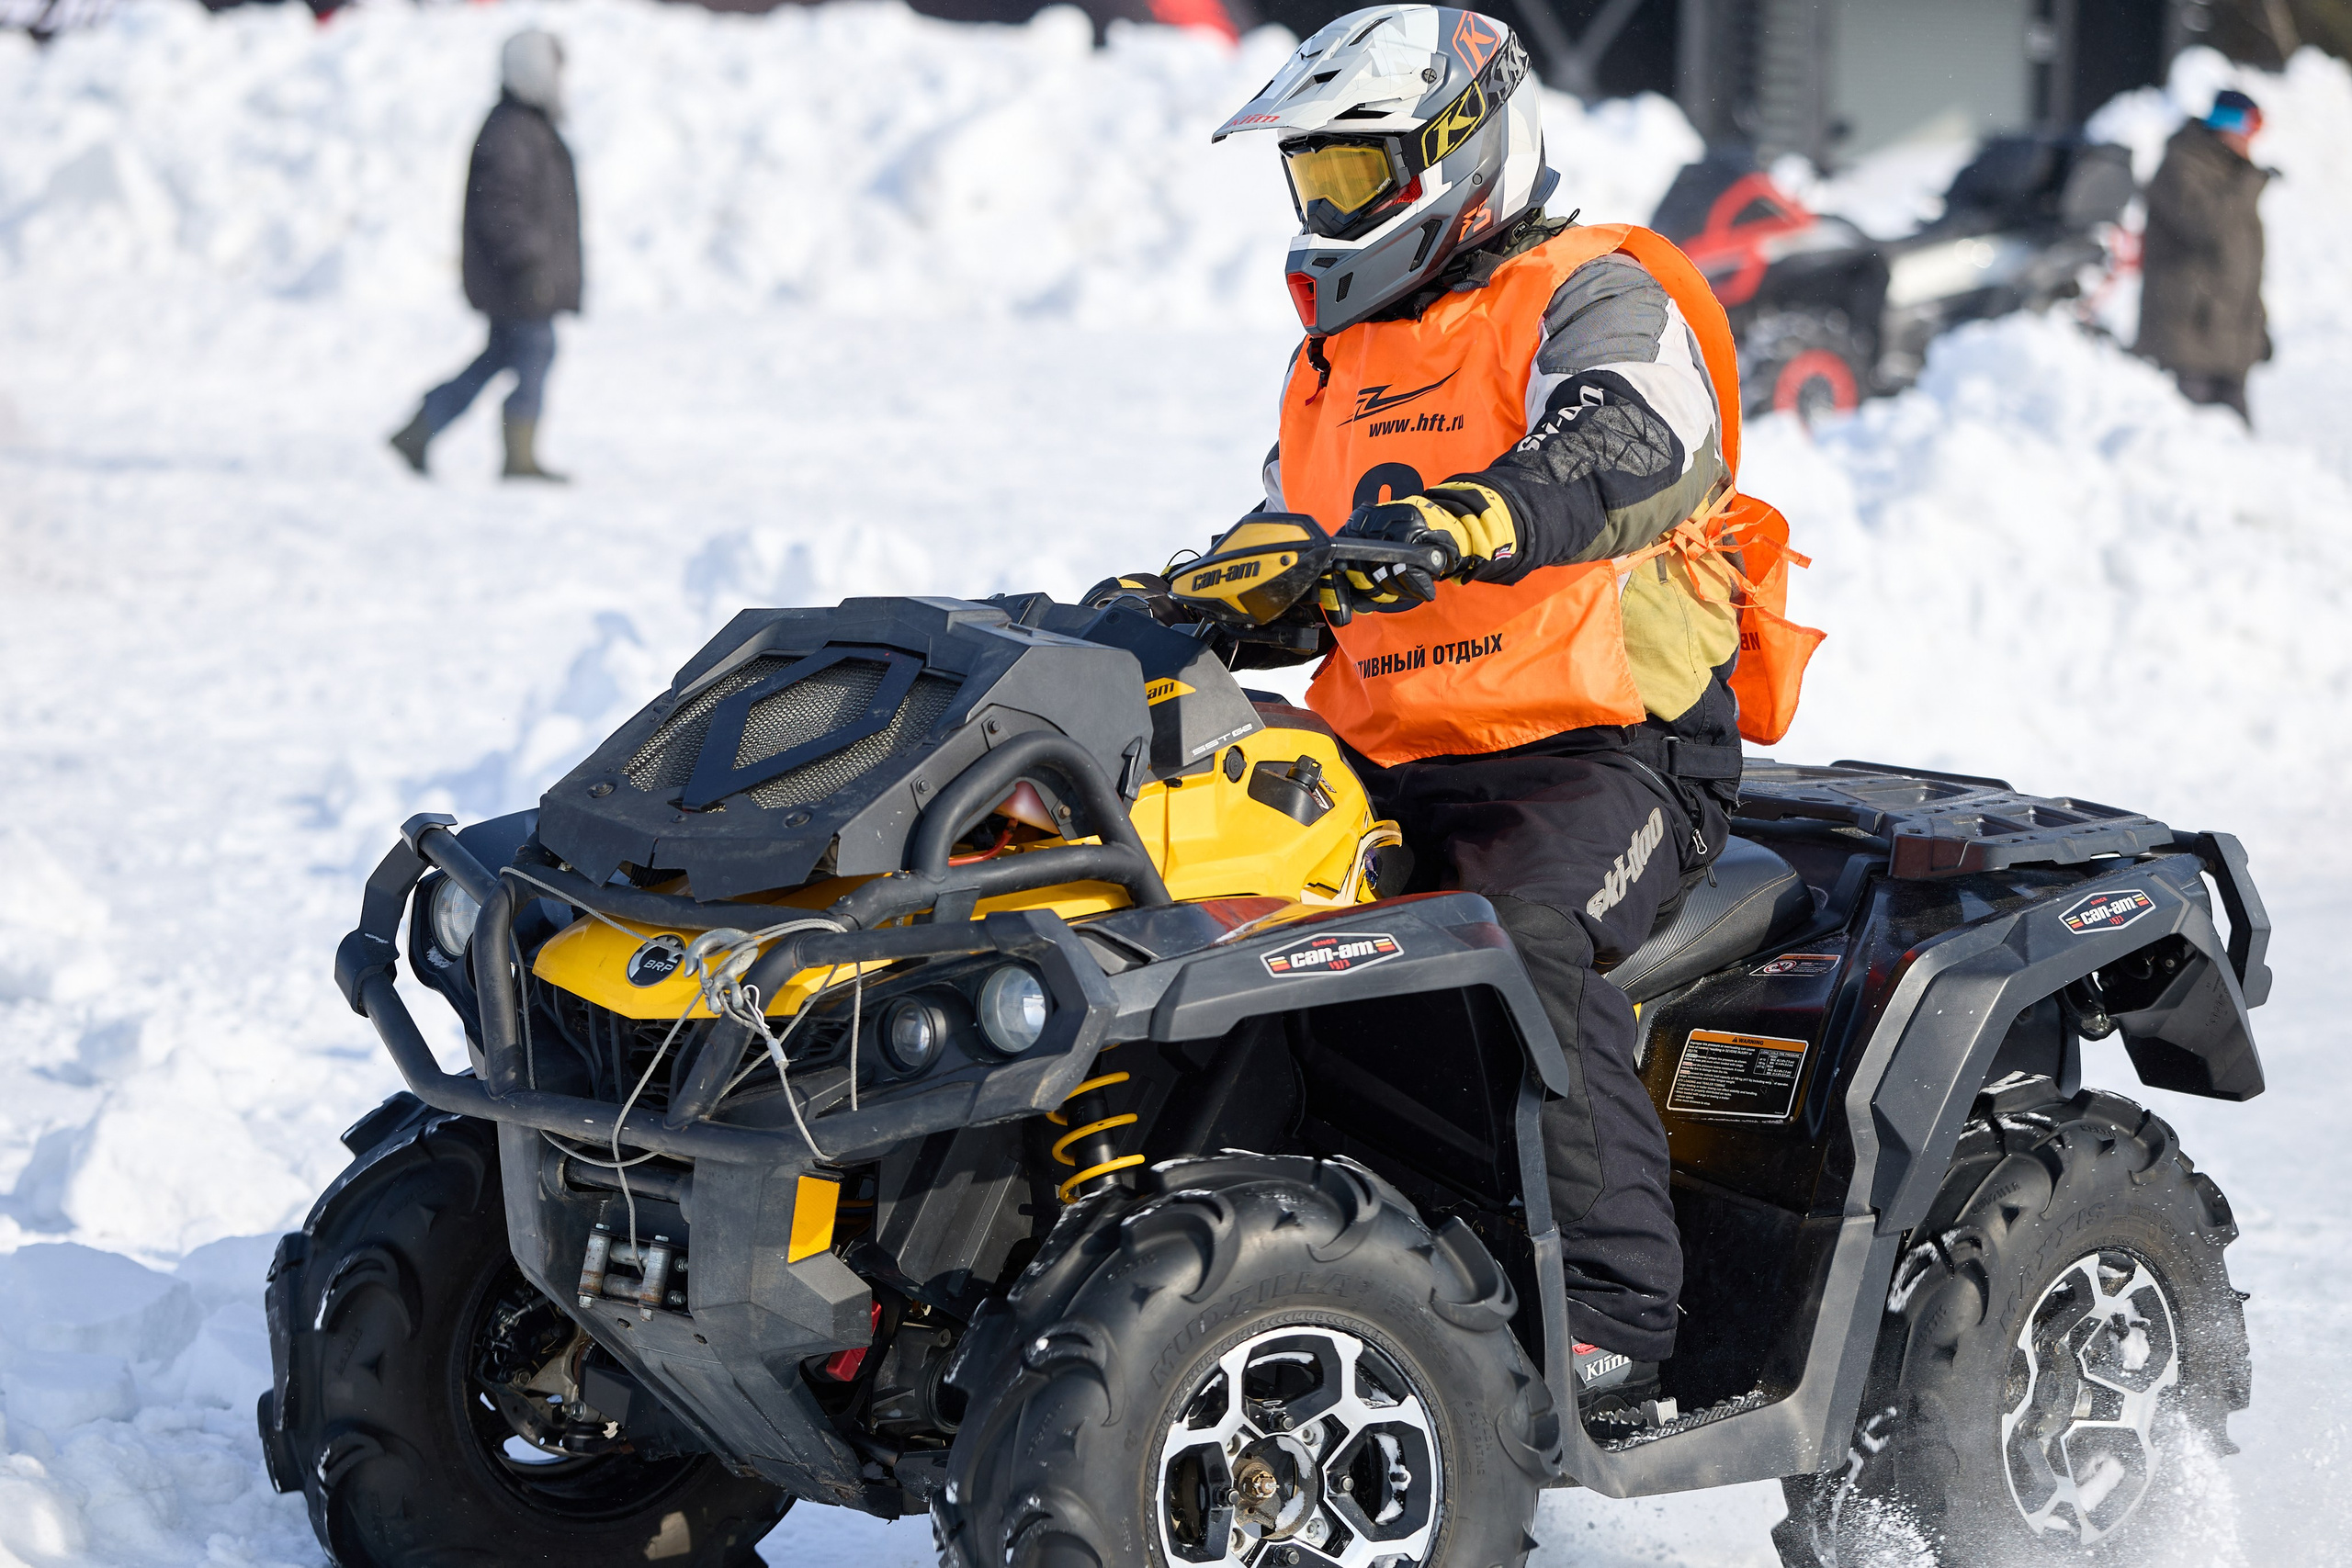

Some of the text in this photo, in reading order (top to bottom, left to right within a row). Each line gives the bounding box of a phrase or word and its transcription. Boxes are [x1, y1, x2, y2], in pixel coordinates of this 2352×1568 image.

[1369, 413, 1464, 437] www.hft.ru
[1192, 561, 1261, 592] can-am
[1432, 633, 1503, 665] ОТДЫХ
[2079, 897, 2137, 925] can-am
[643, 959, 674, 973] BRP
[1290, 941, 1374, 968] can-am
[1738, 1037, 1764, 1046] WARNING
